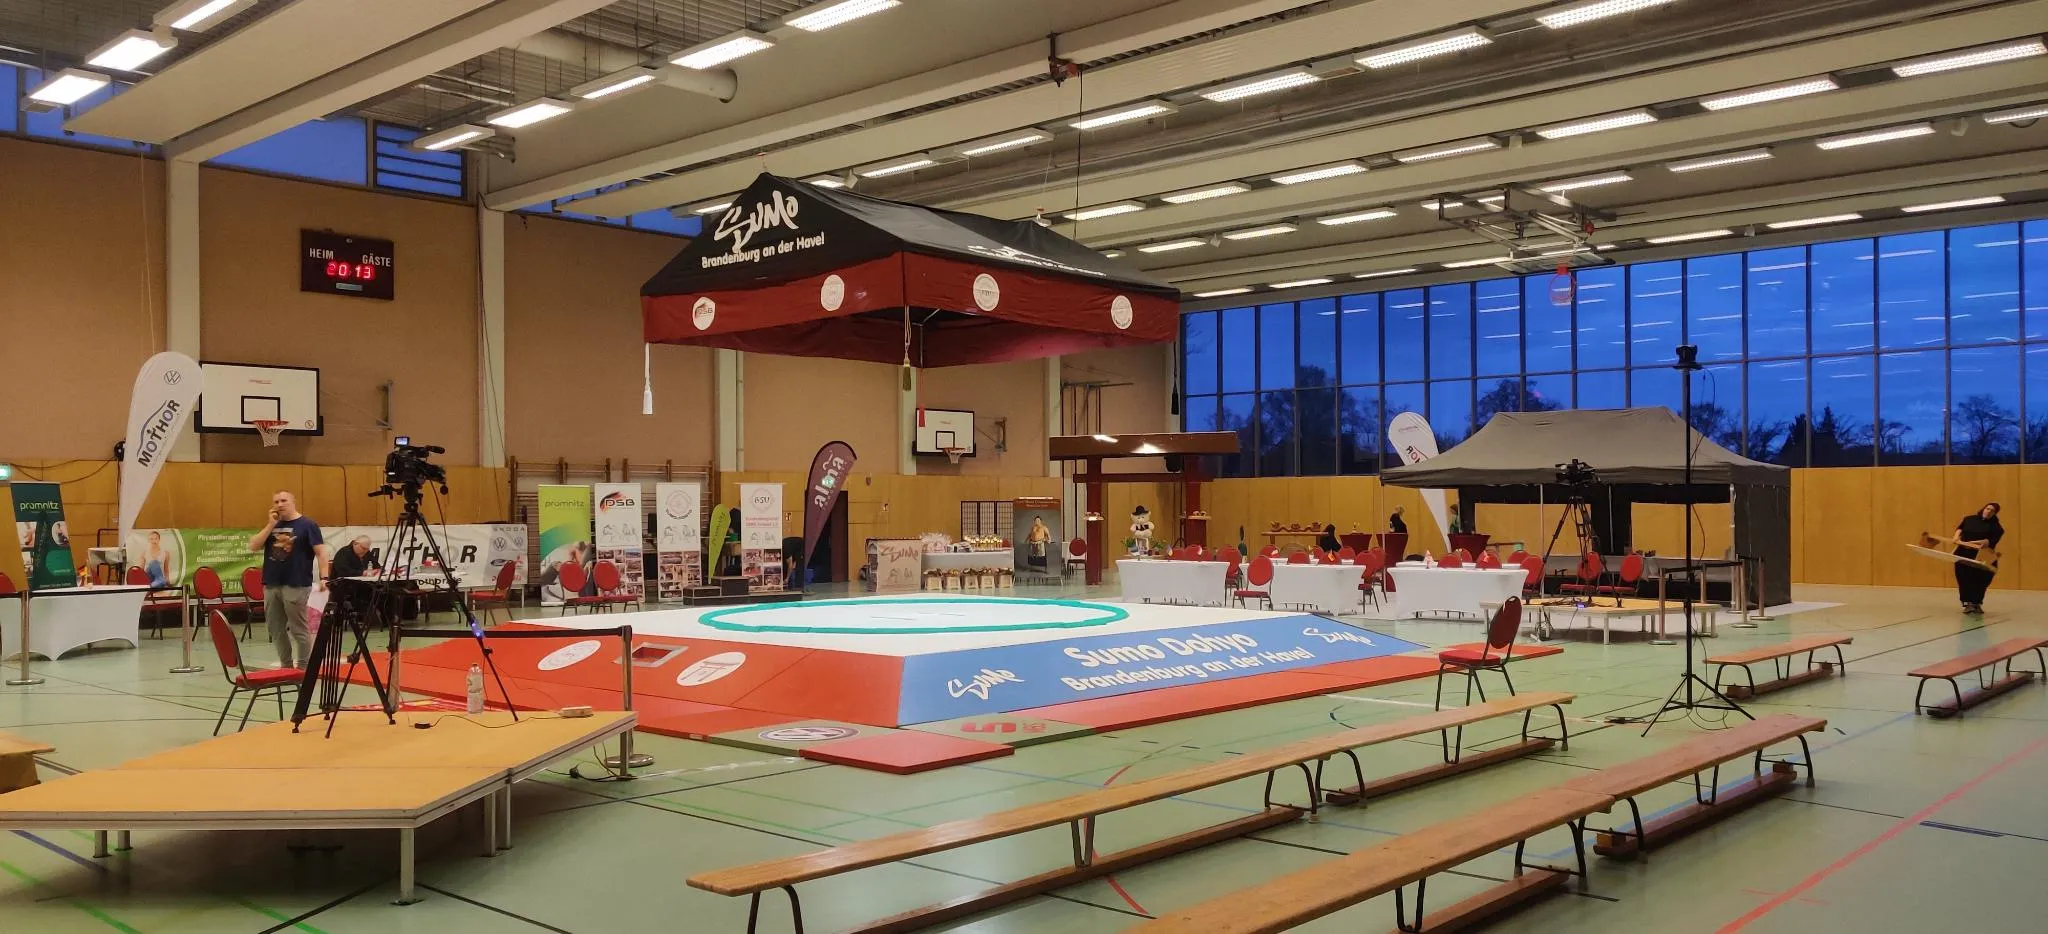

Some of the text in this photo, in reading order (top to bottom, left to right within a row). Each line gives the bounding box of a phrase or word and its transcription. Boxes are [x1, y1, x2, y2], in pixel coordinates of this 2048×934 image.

[309, 247, 334, 260] HEIM
[362, 252, 391, 267] GÄSTE
[702, 231, 826, 269] Brandenburg an der Havel
[137, 399, 181, 468] MOTHOR
[1060, 646, 1317, 691] Brandenburg an der Havel
[1063, 632, 1258, 668] Sumo Dohyo
